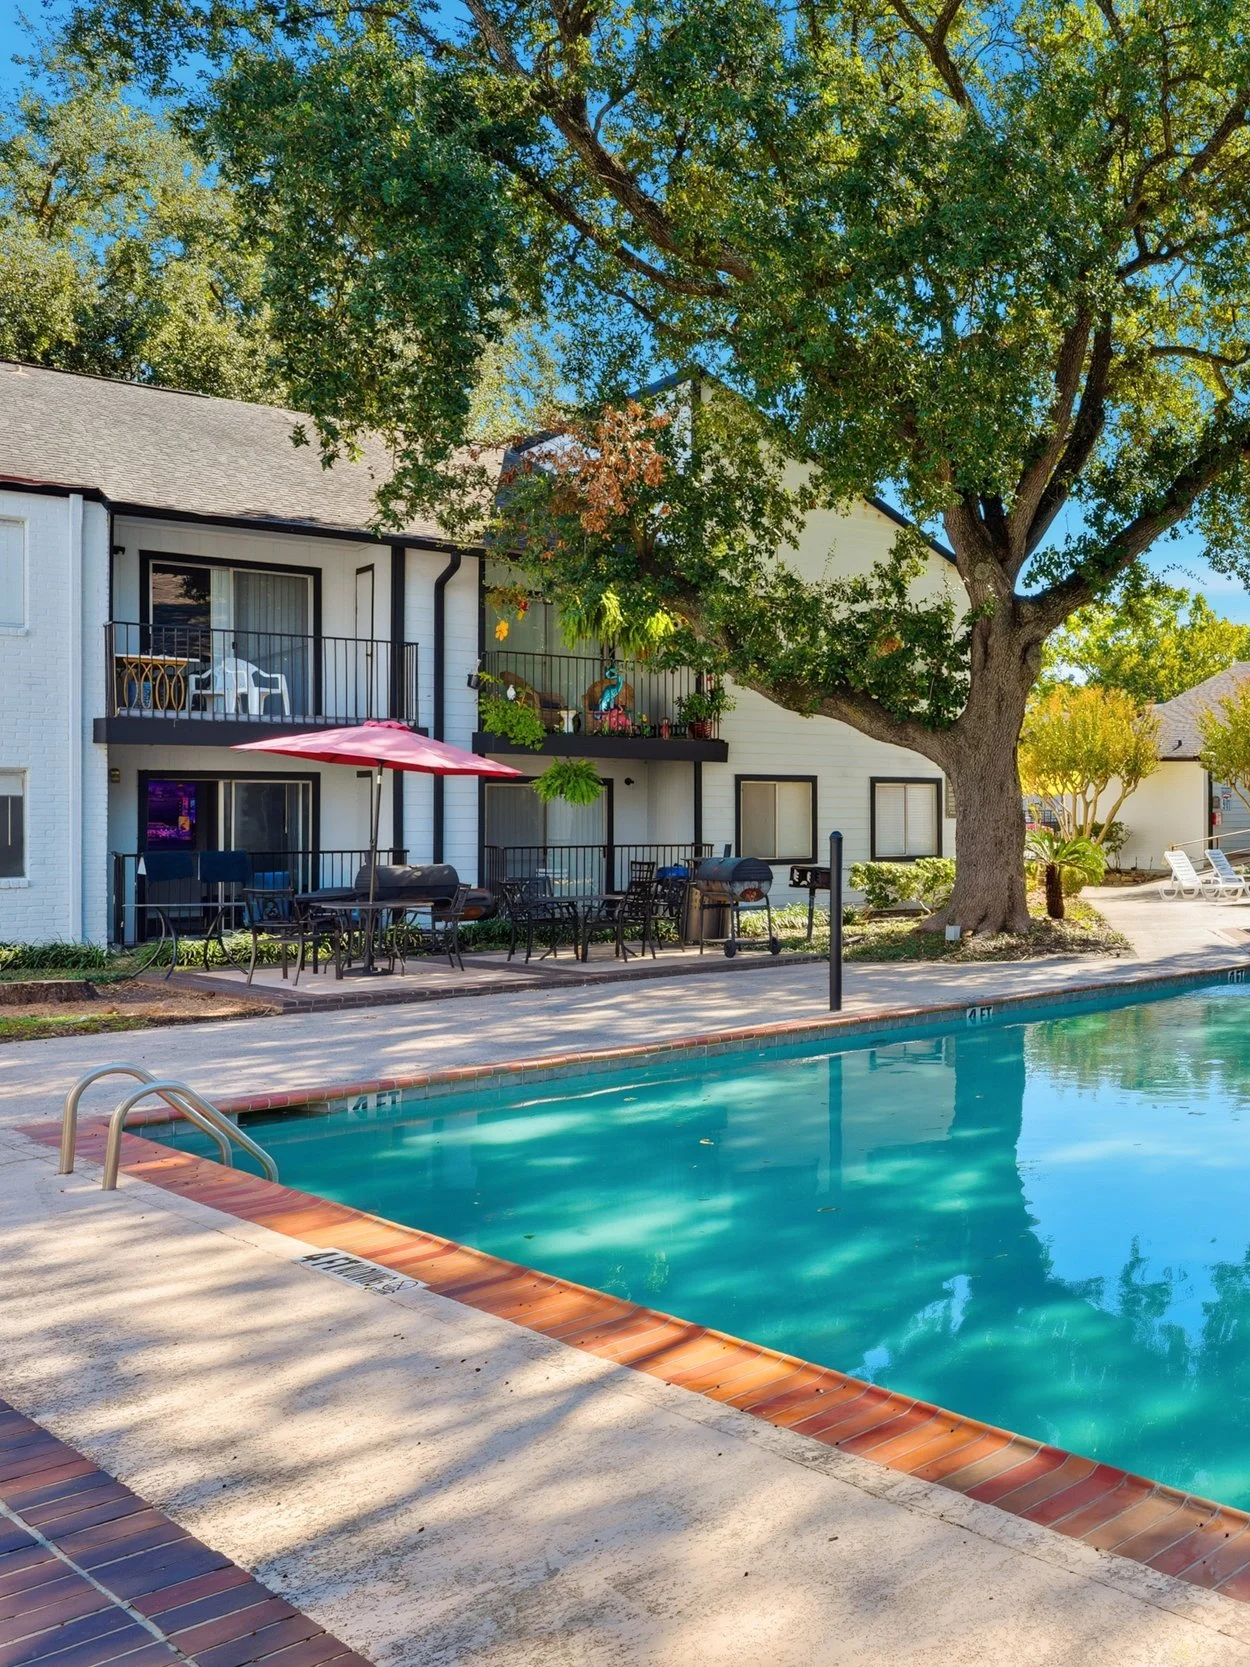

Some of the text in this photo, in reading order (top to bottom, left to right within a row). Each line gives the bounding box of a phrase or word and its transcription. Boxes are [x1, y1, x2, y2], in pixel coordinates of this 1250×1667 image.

[969, 1006, 992, 1018] 4 FT
[352, 1090, 400, 1110] 4 FT
[301, 1252, 339, 1262] 4
